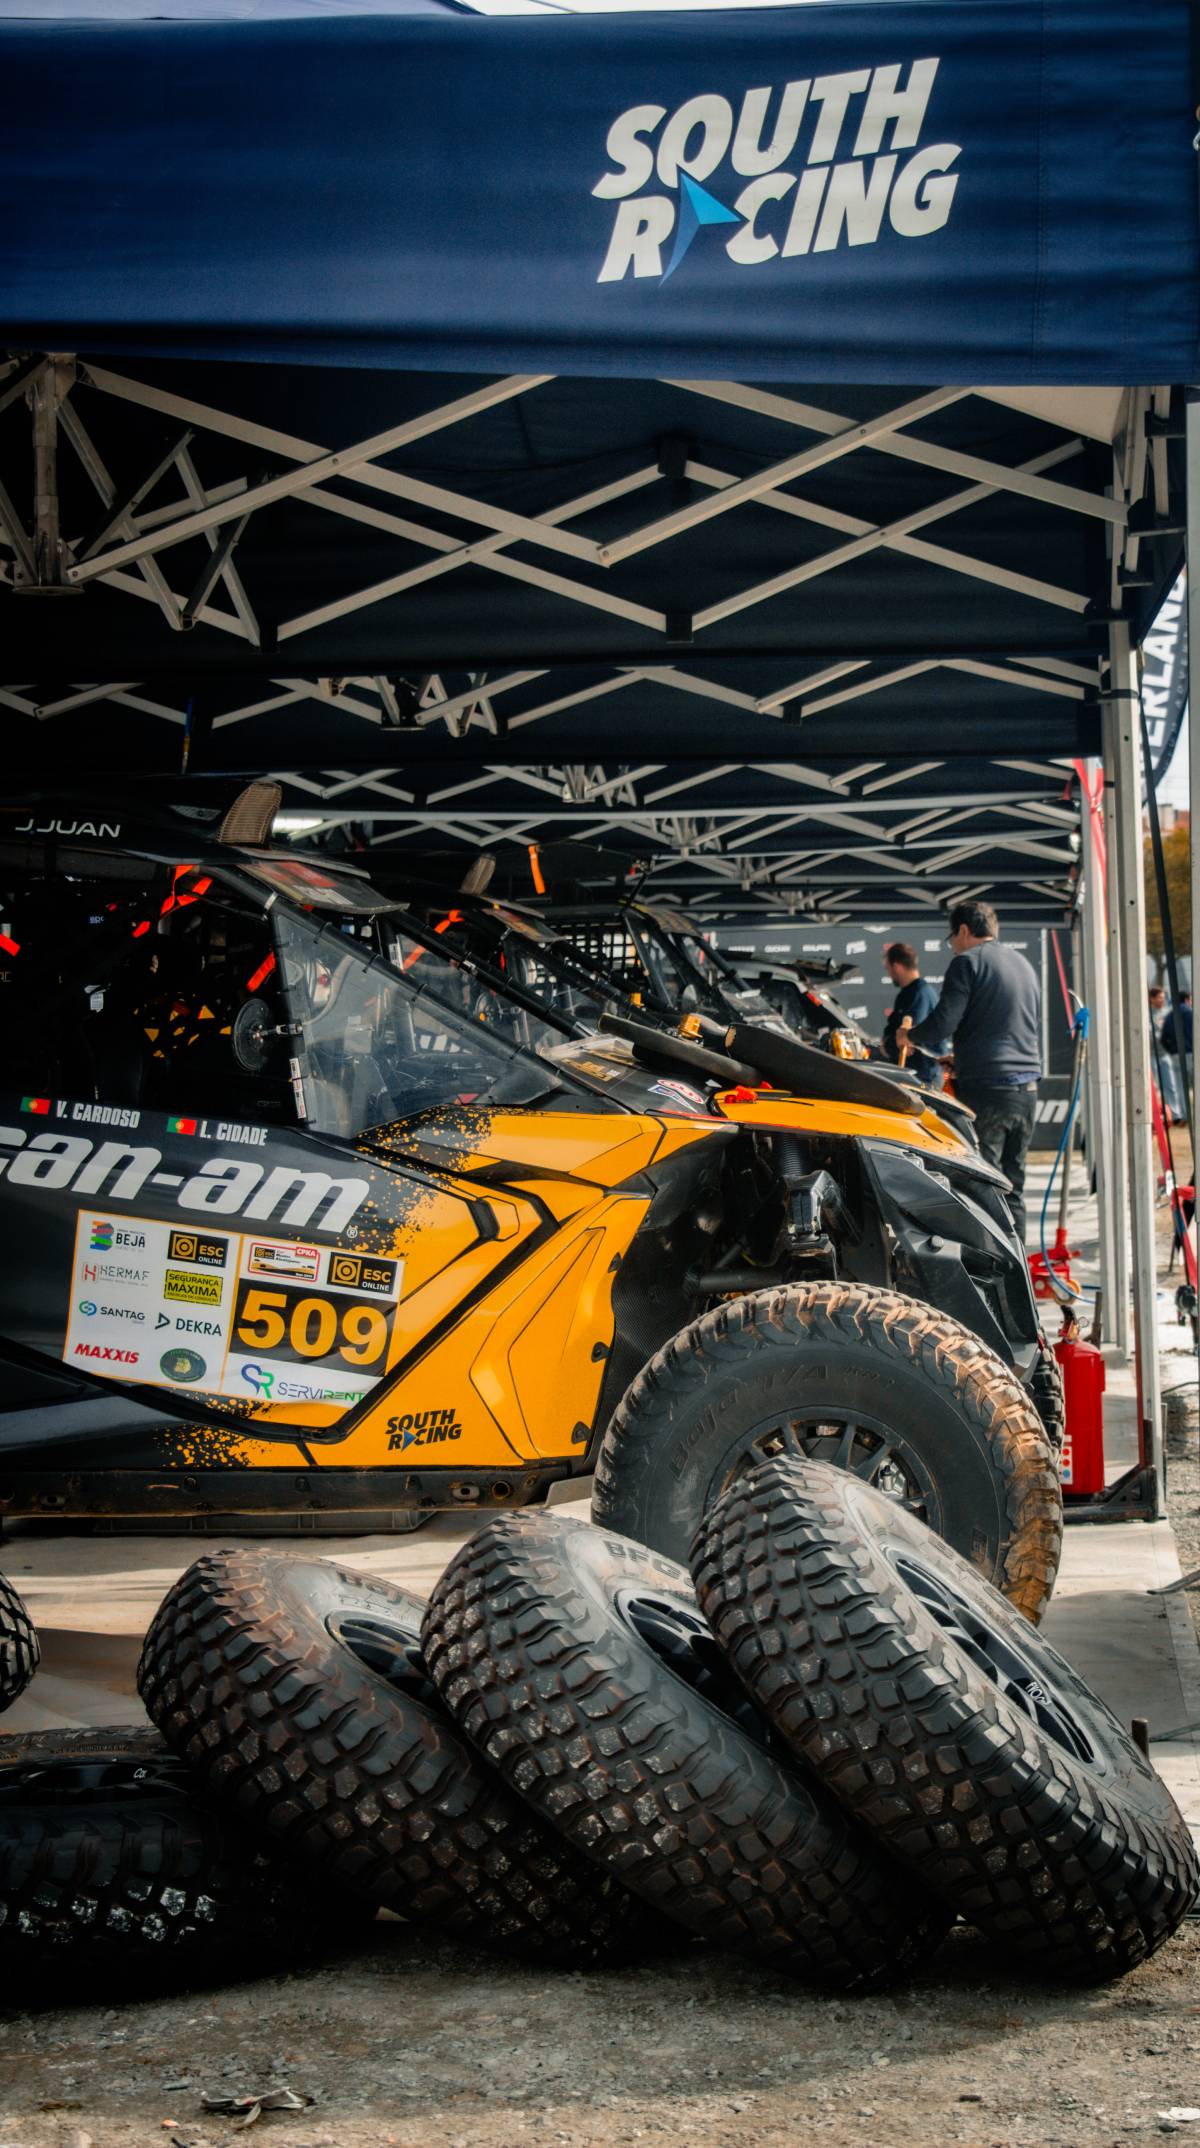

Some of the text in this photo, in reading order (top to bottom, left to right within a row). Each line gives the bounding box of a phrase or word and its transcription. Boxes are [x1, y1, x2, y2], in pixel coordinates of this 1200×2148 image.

[591, 57, 940, 199] SOUTH
[56, 1100, 141, 1129] V. CARDOSO
[199, 1120, 268, 1146] L. CIDADE
[115, 1232, 146, 1248] BEJA
[198, 1256, 223, 1265] ONLINE
[199, 1246, 224, 1258] ESC
[169, 1274, 219, 1287] SEGURANÇA
[363, 1268, 392, 1283] ESC
[167, 1281, 218, 1298] MÁXIMA
[362, 1281, 390, 1292] ONLINE
[100, 1306, 146, 1321] SANTAG
[176, 1318, 222, 1336] DEKRA
[237, 1289, 388, 1366] 509
[74, 1343, 140, 1364] MAXXIS
[385, 1408, 456, 1434] SOUTH
